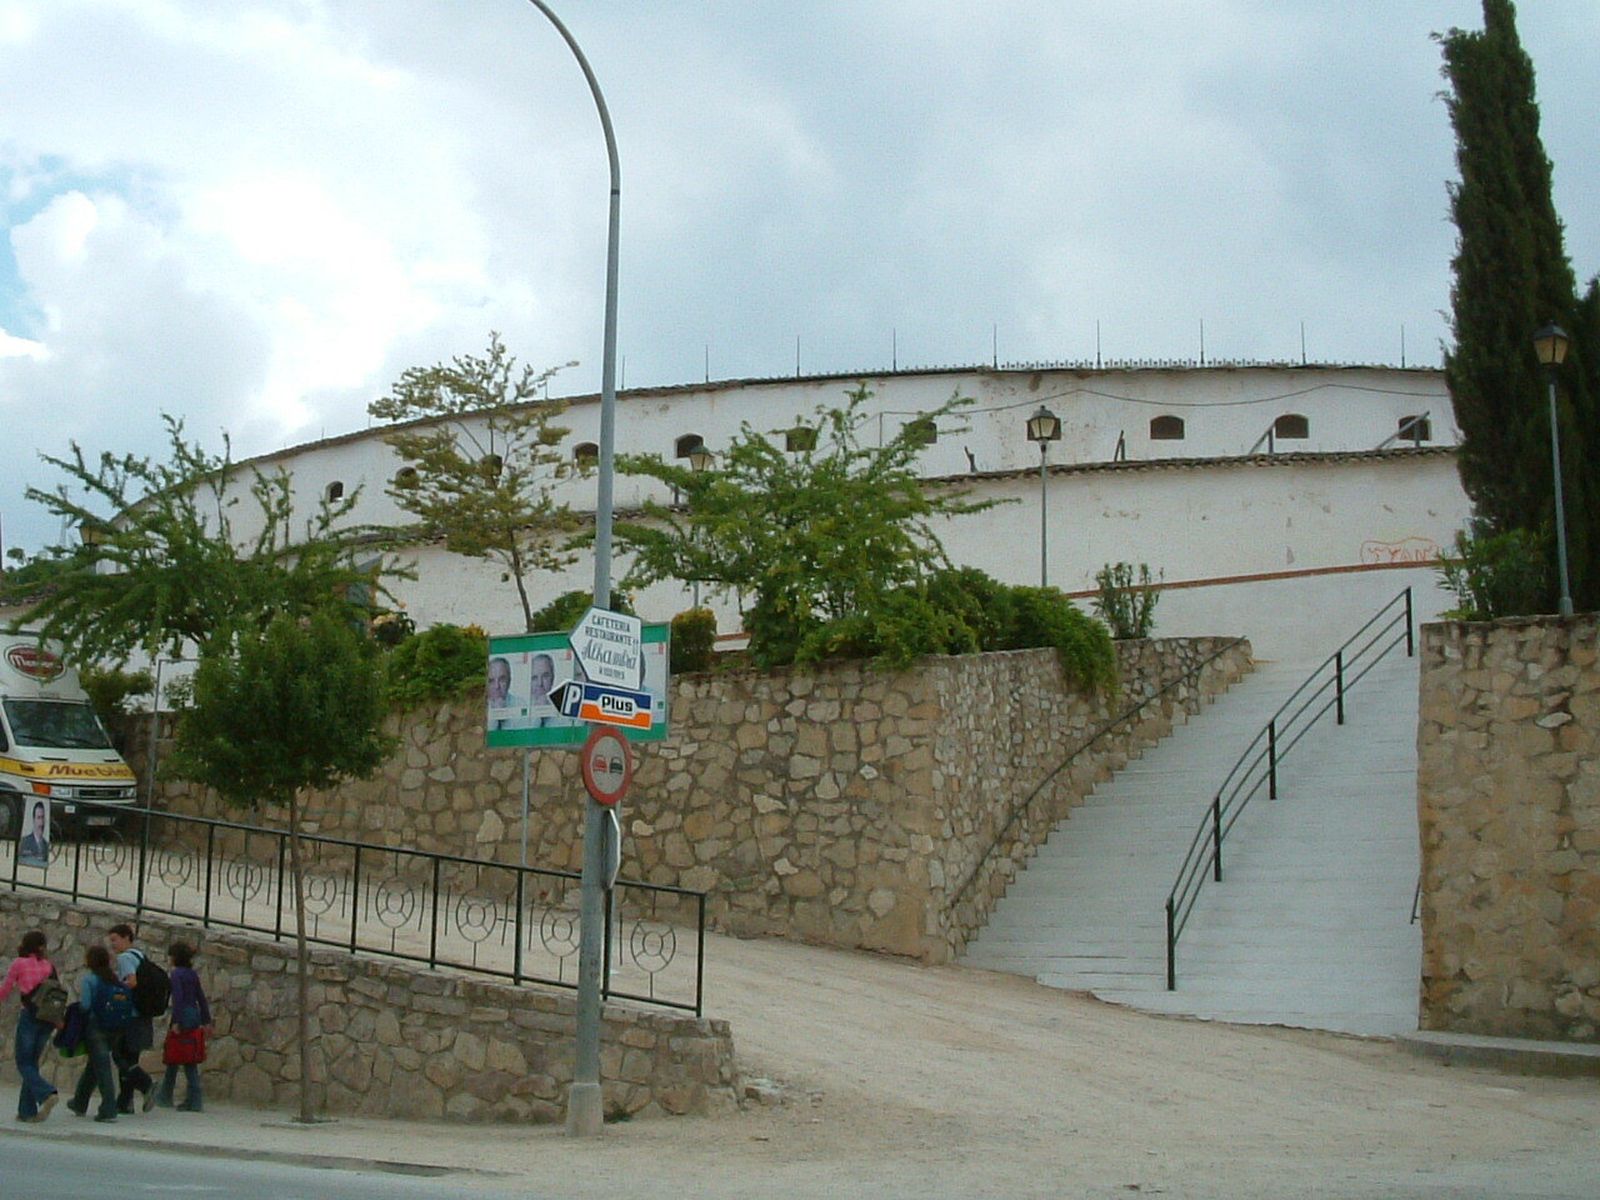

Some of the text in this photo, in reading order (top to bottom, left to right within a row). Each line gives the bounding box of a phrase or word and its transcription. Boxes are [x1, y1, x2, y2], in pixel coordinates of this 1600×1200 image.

[585, 626, 633, 646] RESTAURANTE
[564, 685, 581, 715] P
[602, 696, 633, 713] Plus
